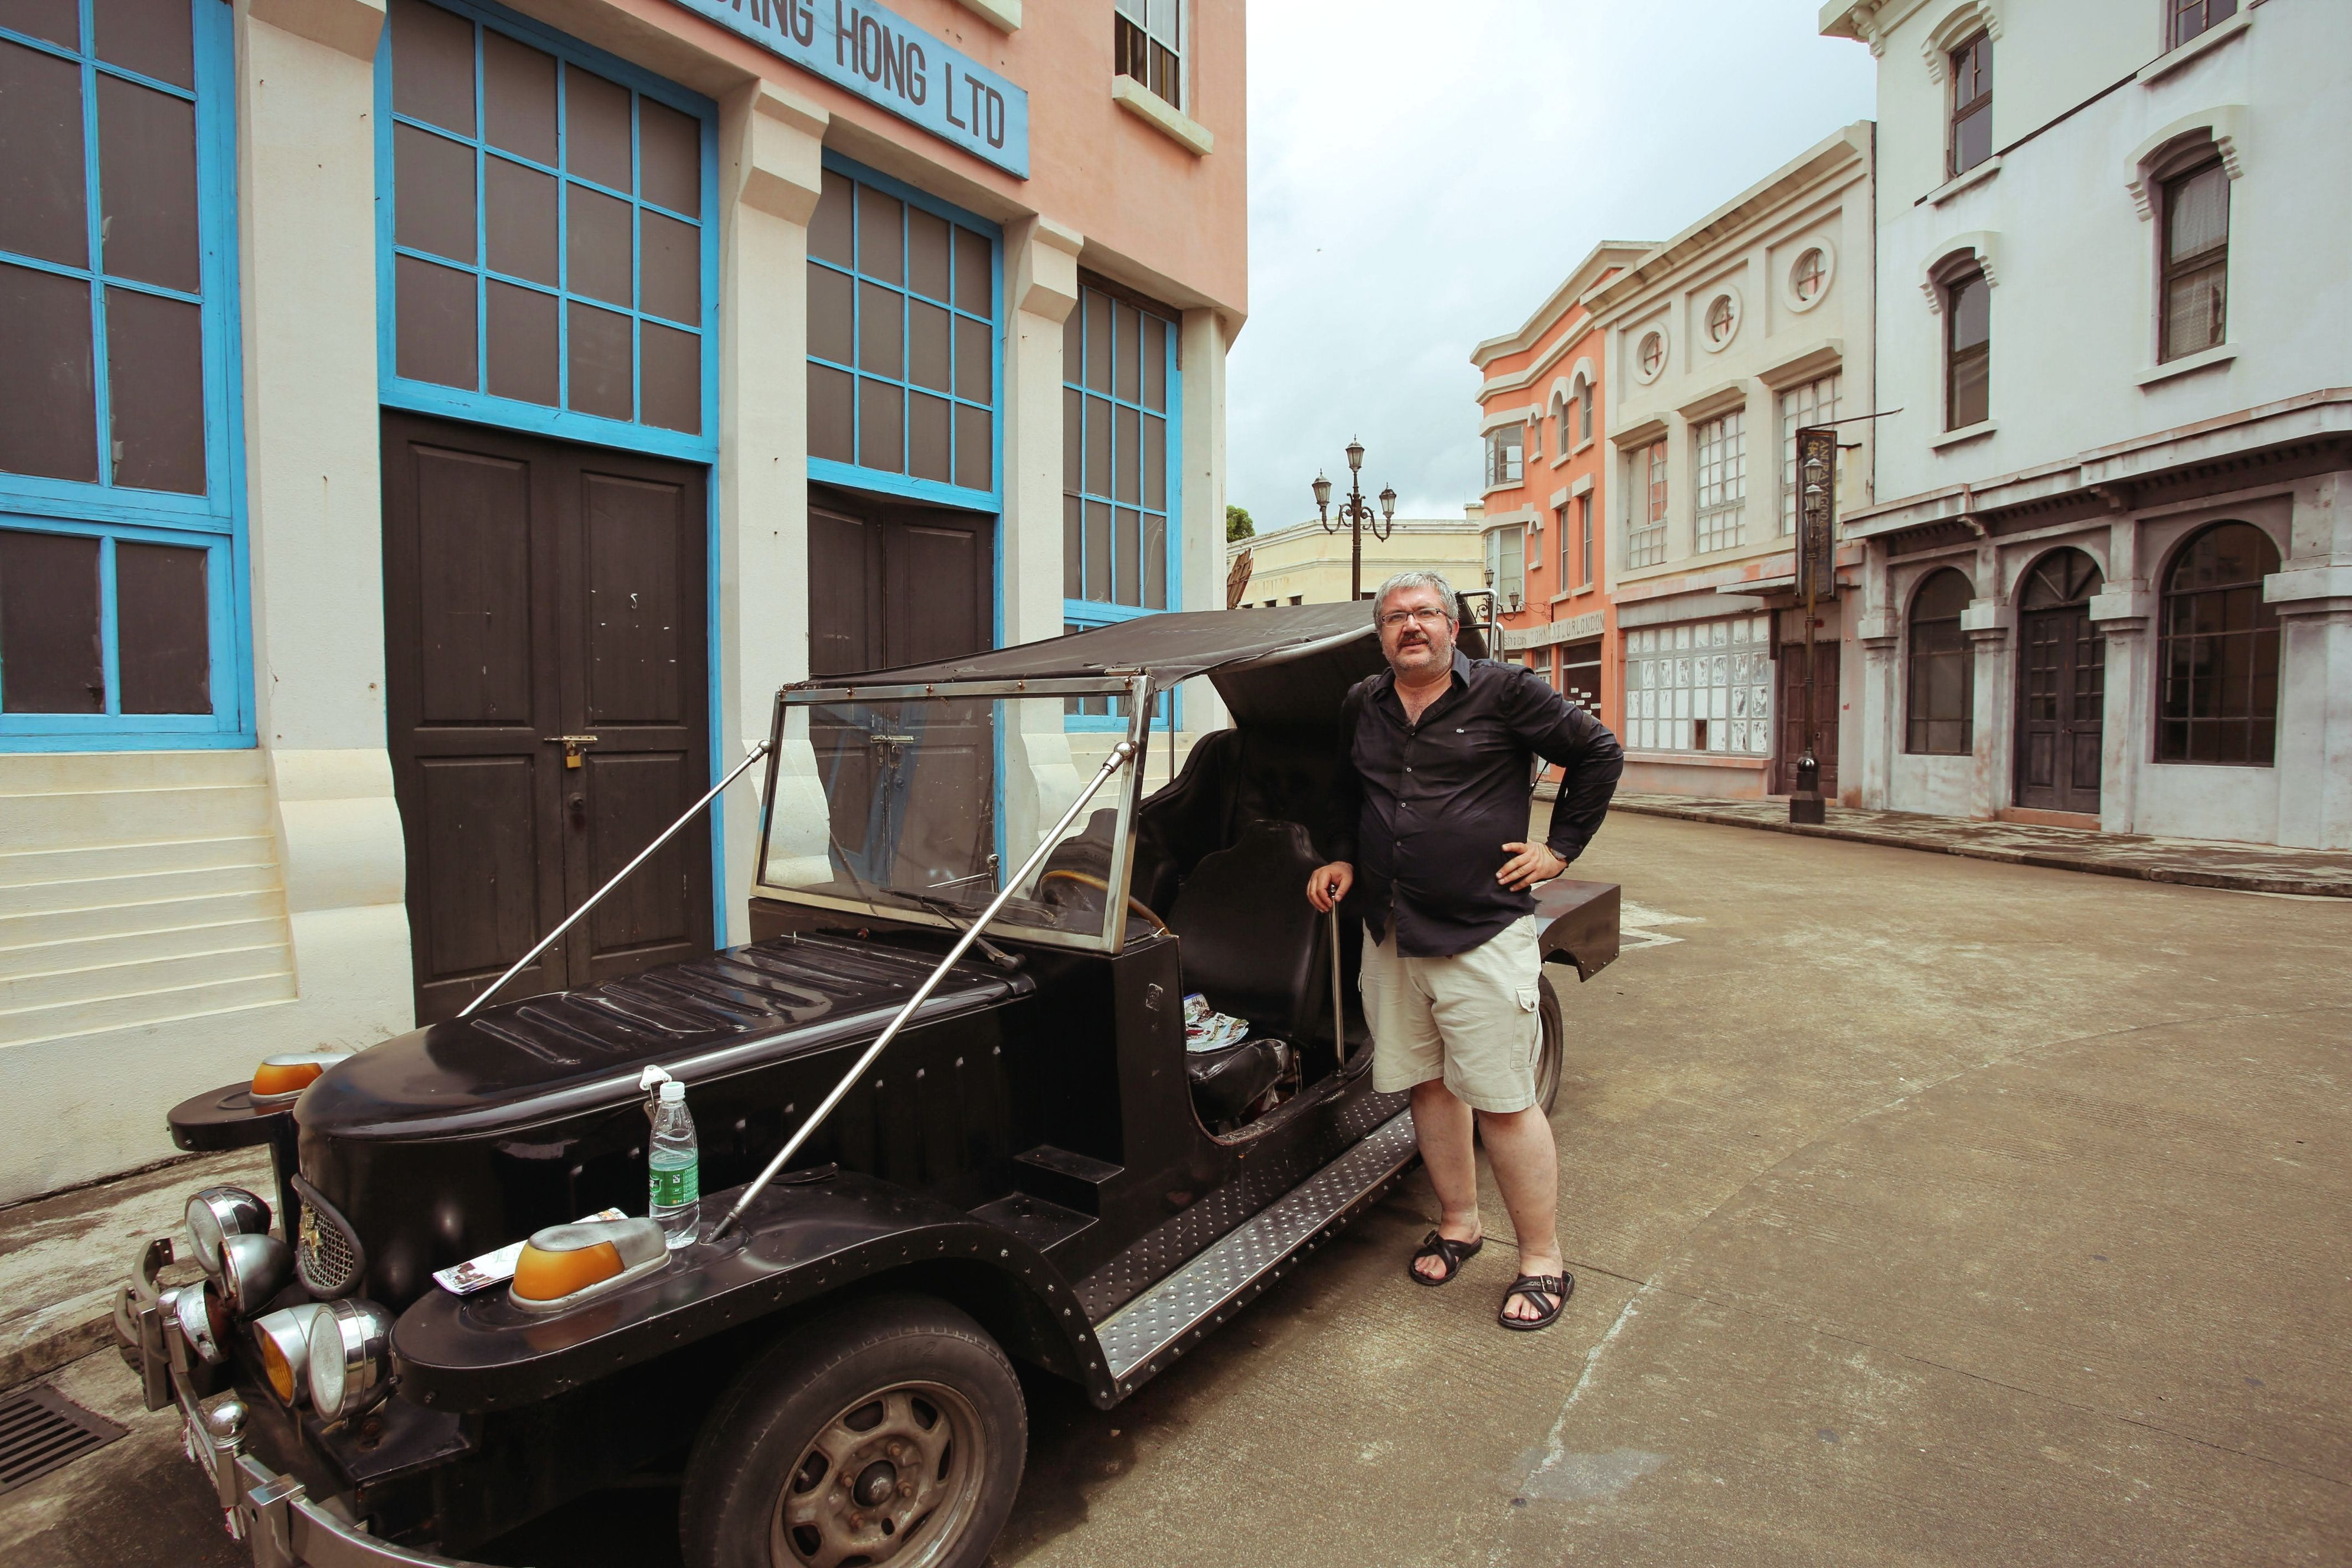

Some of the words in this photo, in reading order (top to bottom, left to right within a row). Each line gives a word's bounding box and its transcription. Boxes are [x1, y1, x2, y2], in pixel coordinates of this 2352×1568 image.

[835, 0, 926, 106] HONG
[945, 62, 1004, 149] LTD
[1819, 440, 1829, 481] ANURA
